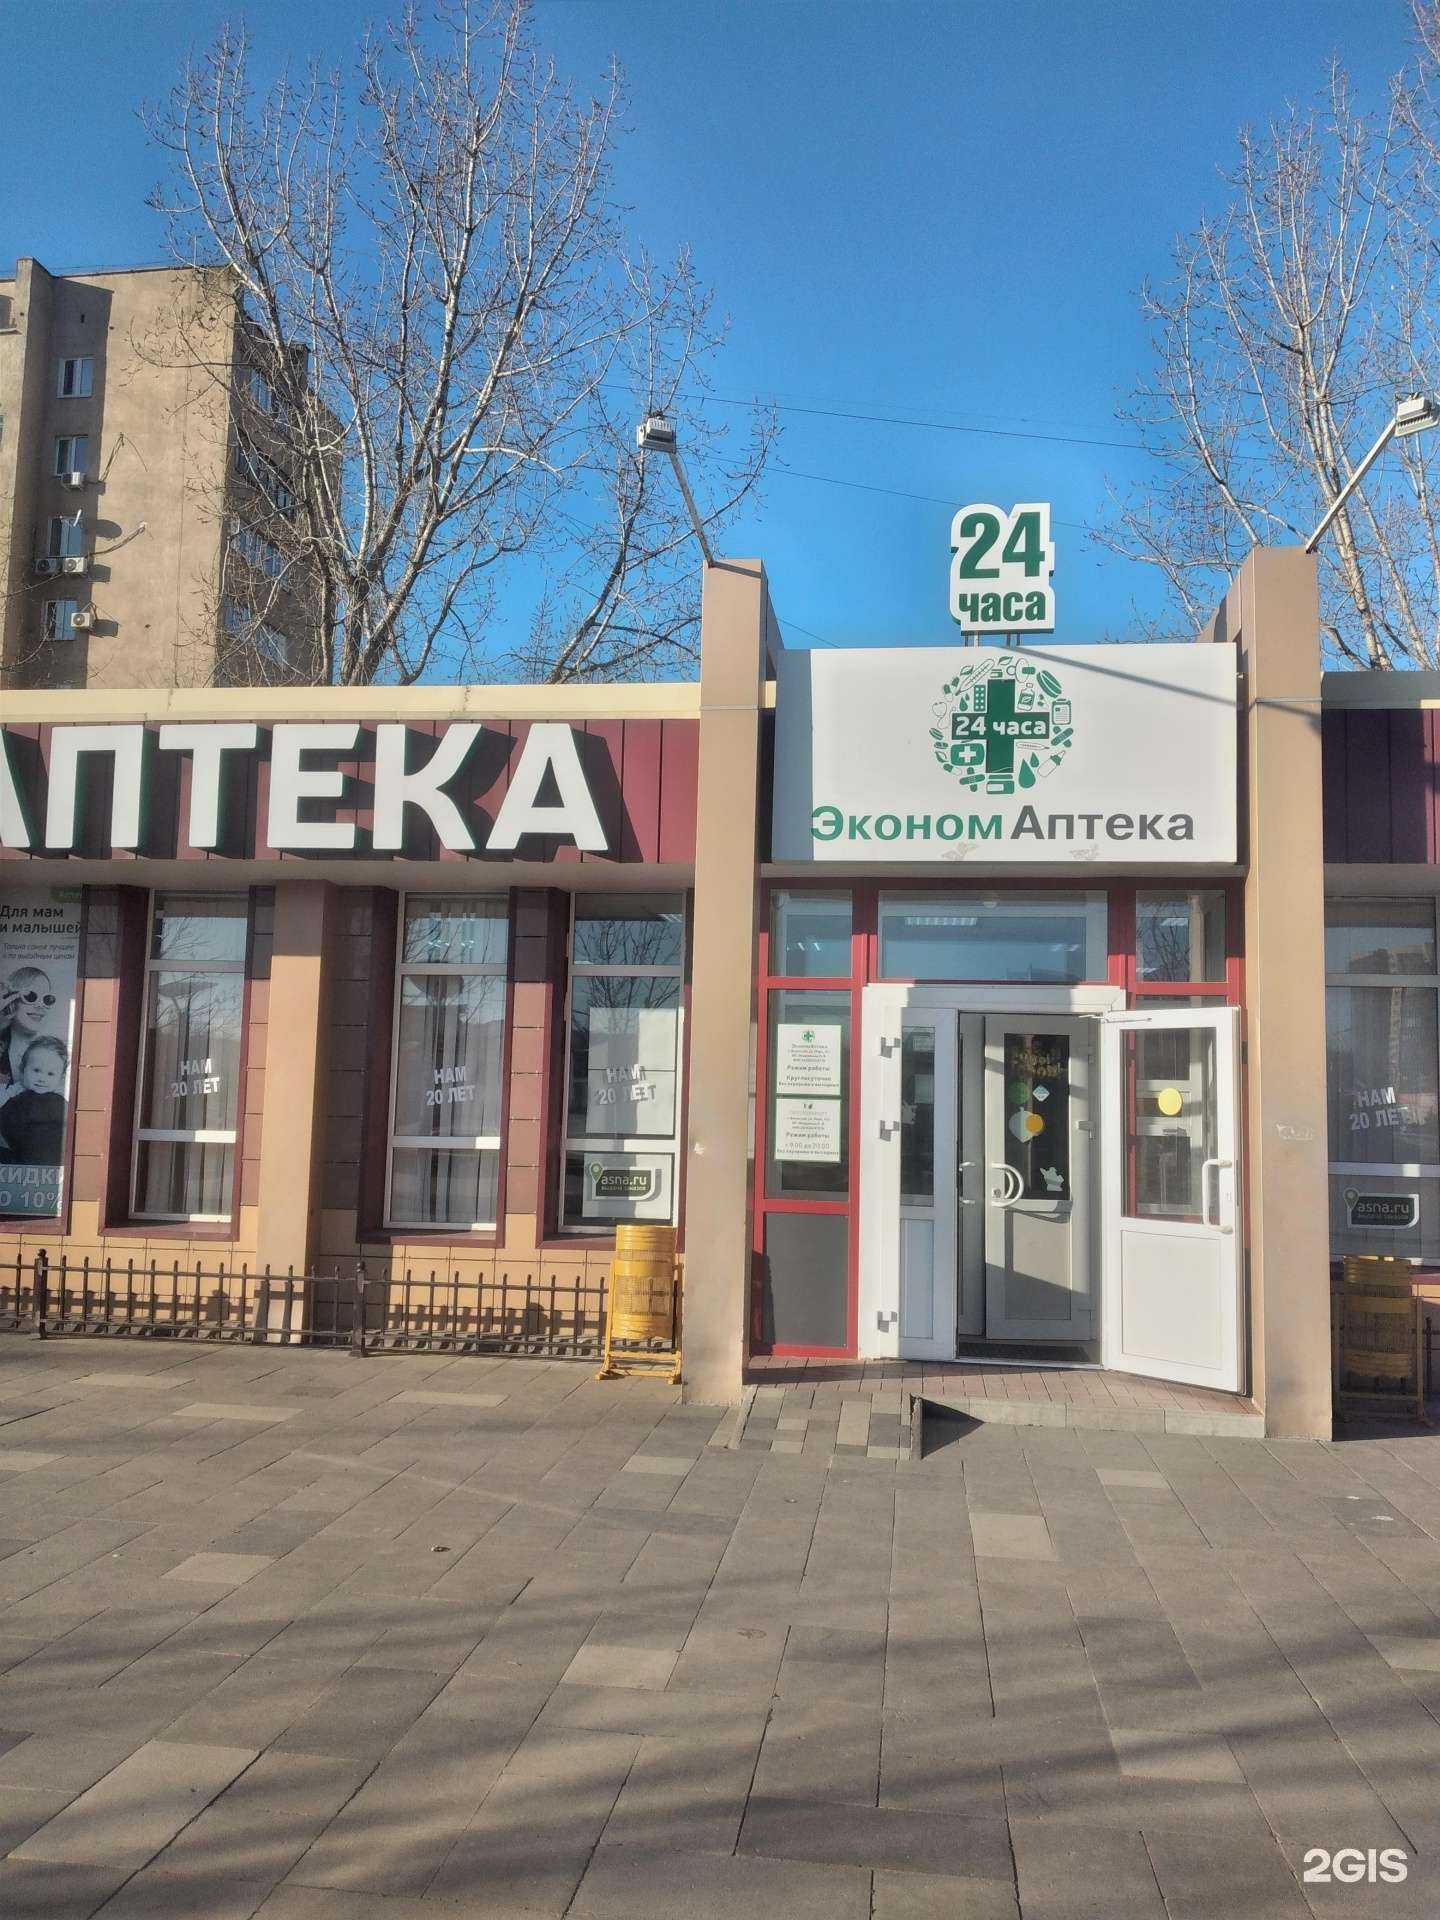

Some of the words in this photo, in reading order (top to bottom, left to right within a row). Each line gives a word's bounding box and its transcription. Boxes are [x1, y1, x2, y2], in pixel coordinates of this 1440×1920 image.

[959, 511, 1046, 579] 24
[958, 591, 1046, 622] часа
[955, 716, 987, 736] 24
[992, 719, 1047, 736] часа
[0, 905, 28, 919] Для
[33, 908, 64, 918] мам
[0, 924, 8, 933] и
[181, 1058, 213, 1075] НАМ
[434, 1066, 467, 1084] НАМ
[170, 1082, 187, 1098] 20
[192, 1076, 221, 1096] ЛЕТ
[426, 1089, 443, 1106] 20
[447, 1084, 476, 1104] ЛЕТ
[598, 1087, 616, 1105] 20
[1357, 1087, 1397, 1107] НАМ
[1349, 1111, 1370, 1131] 20
[600, 1174, 647, 1186] asna.ru
[21, 1191, 63, 1209] 10%
[1357, 1201, 1410, 1214] asna.ru
